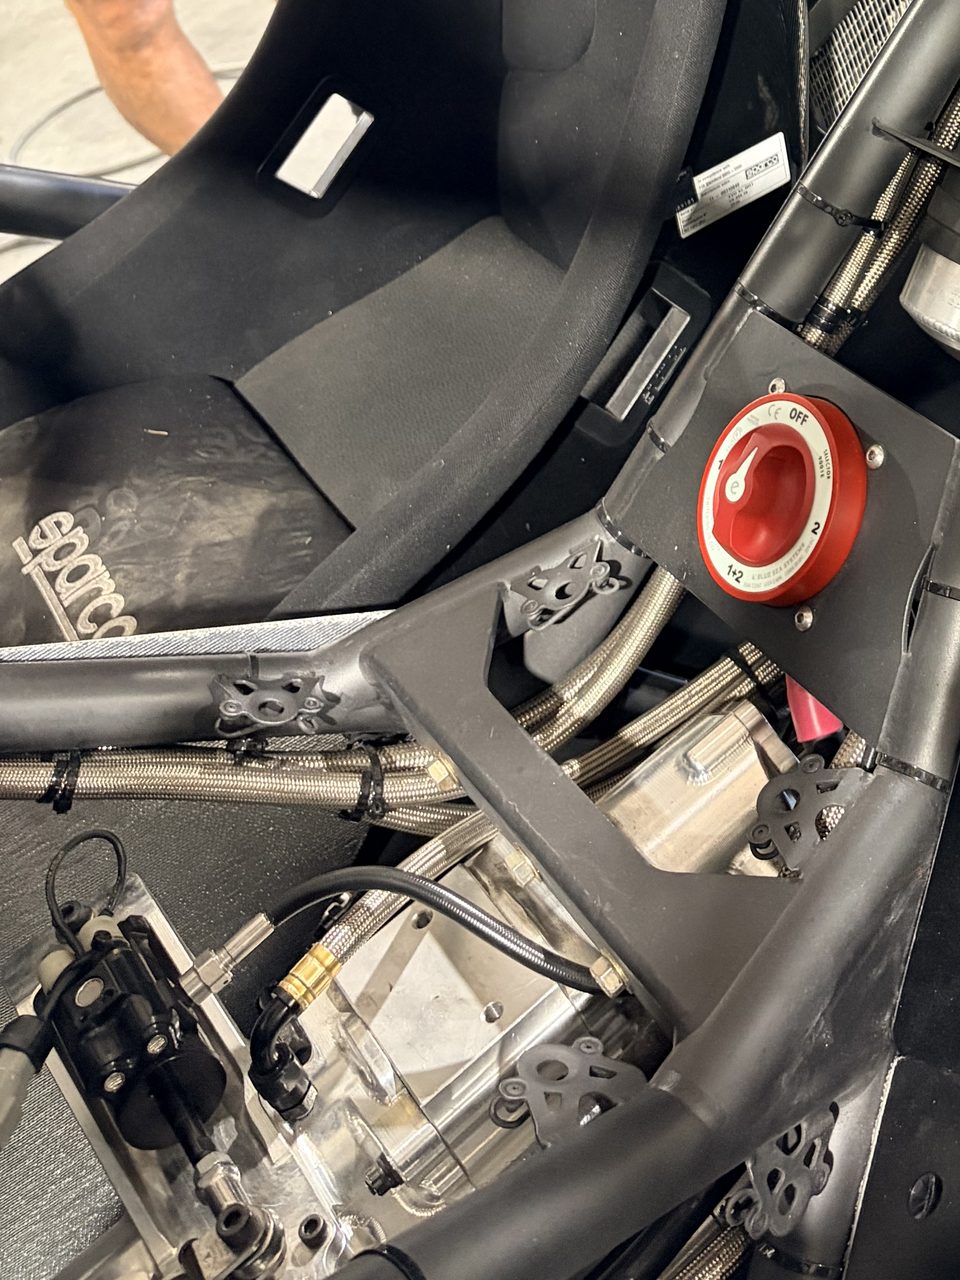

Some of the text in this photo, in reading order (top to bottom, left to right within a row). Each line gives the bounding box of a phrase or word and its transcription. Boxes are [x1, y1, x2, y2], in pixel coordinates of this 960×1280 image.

[789, 408, 809, 426] OFF
[811, 521, 821, 536] 2
[727, 564, 744, 584] 1+2
